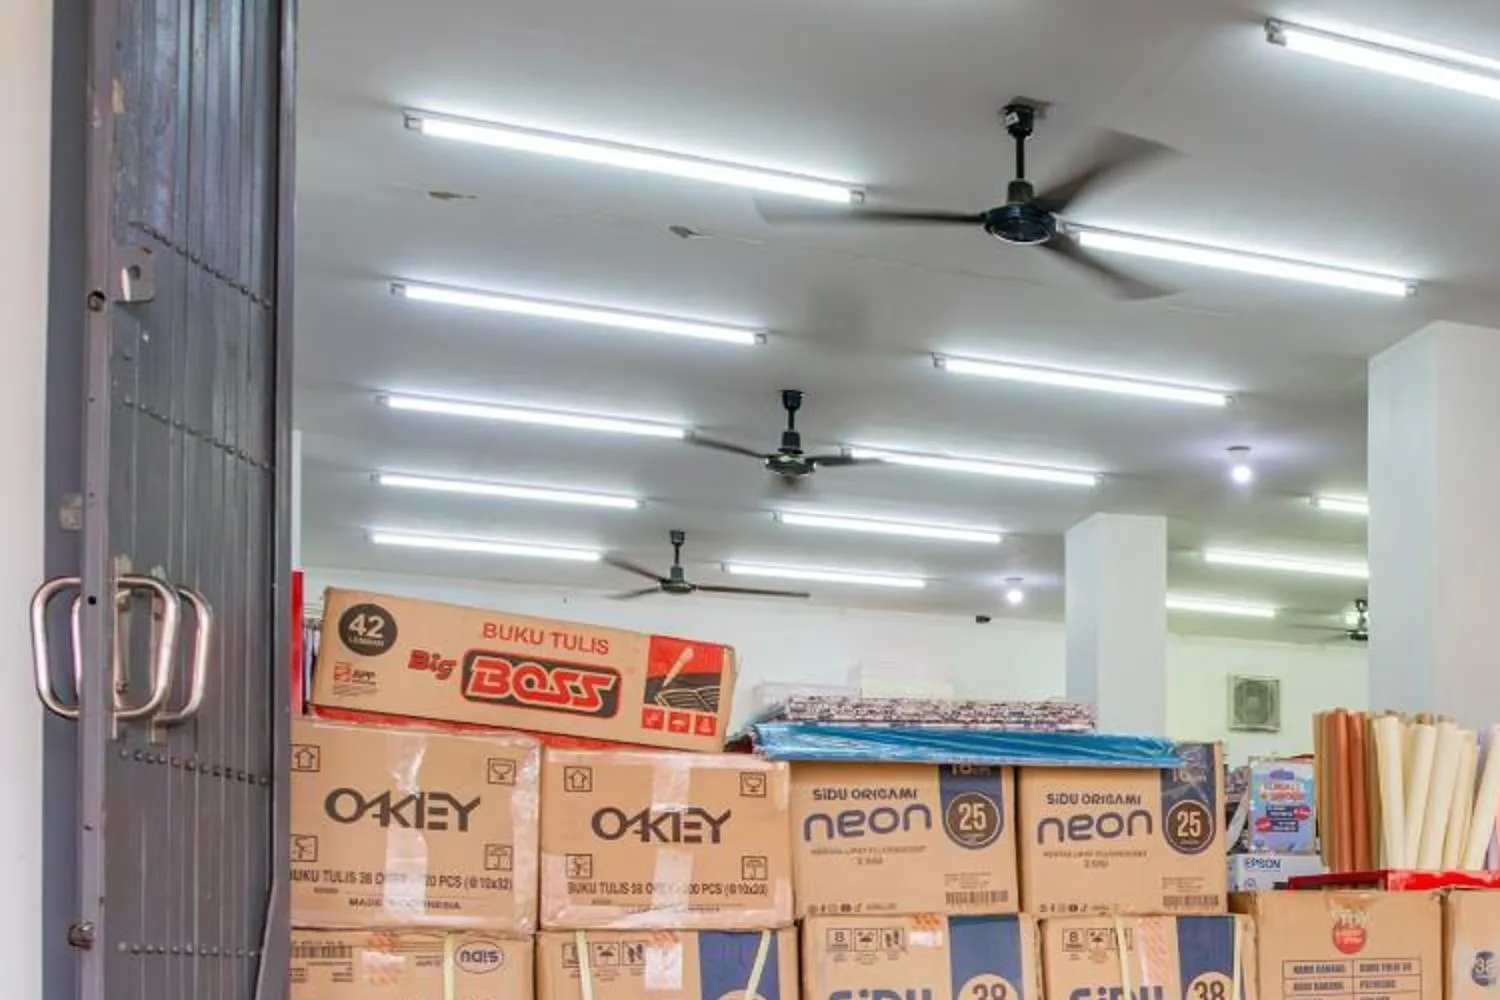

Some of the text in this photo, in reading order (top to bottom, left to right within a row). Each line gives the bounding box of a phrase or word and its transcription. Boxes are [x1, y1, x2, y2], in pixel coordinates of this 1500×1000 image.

[348, 613, 385, 638] 42
[483, 622, 609, 655] BUKU TULIS
[408, 650, 456, 680] Big
[469, 655, 616, 712] BOSS
[812, 788, 918, 801] SiDU ORIGAMI
[1046, 793, 1141, 805] SiDU ORIGAMI
[803, 804, 932, 843] neon
[958, 803, 987, 831] 25
[1037, 810, 1153, 845] neon
[1176, 811, 1202, 837] 25
[1245, 856, 1281, 869] EPSON
[323, 870, 357, 885] TULIS
[439, 876, 462, 889] PCS
[567, 882, 596, 895] BUKU
[600, 882, 629, 895] TULIS
[703, 884, 722, 896] PCS
[460, 950, 499, 963] SiDU
